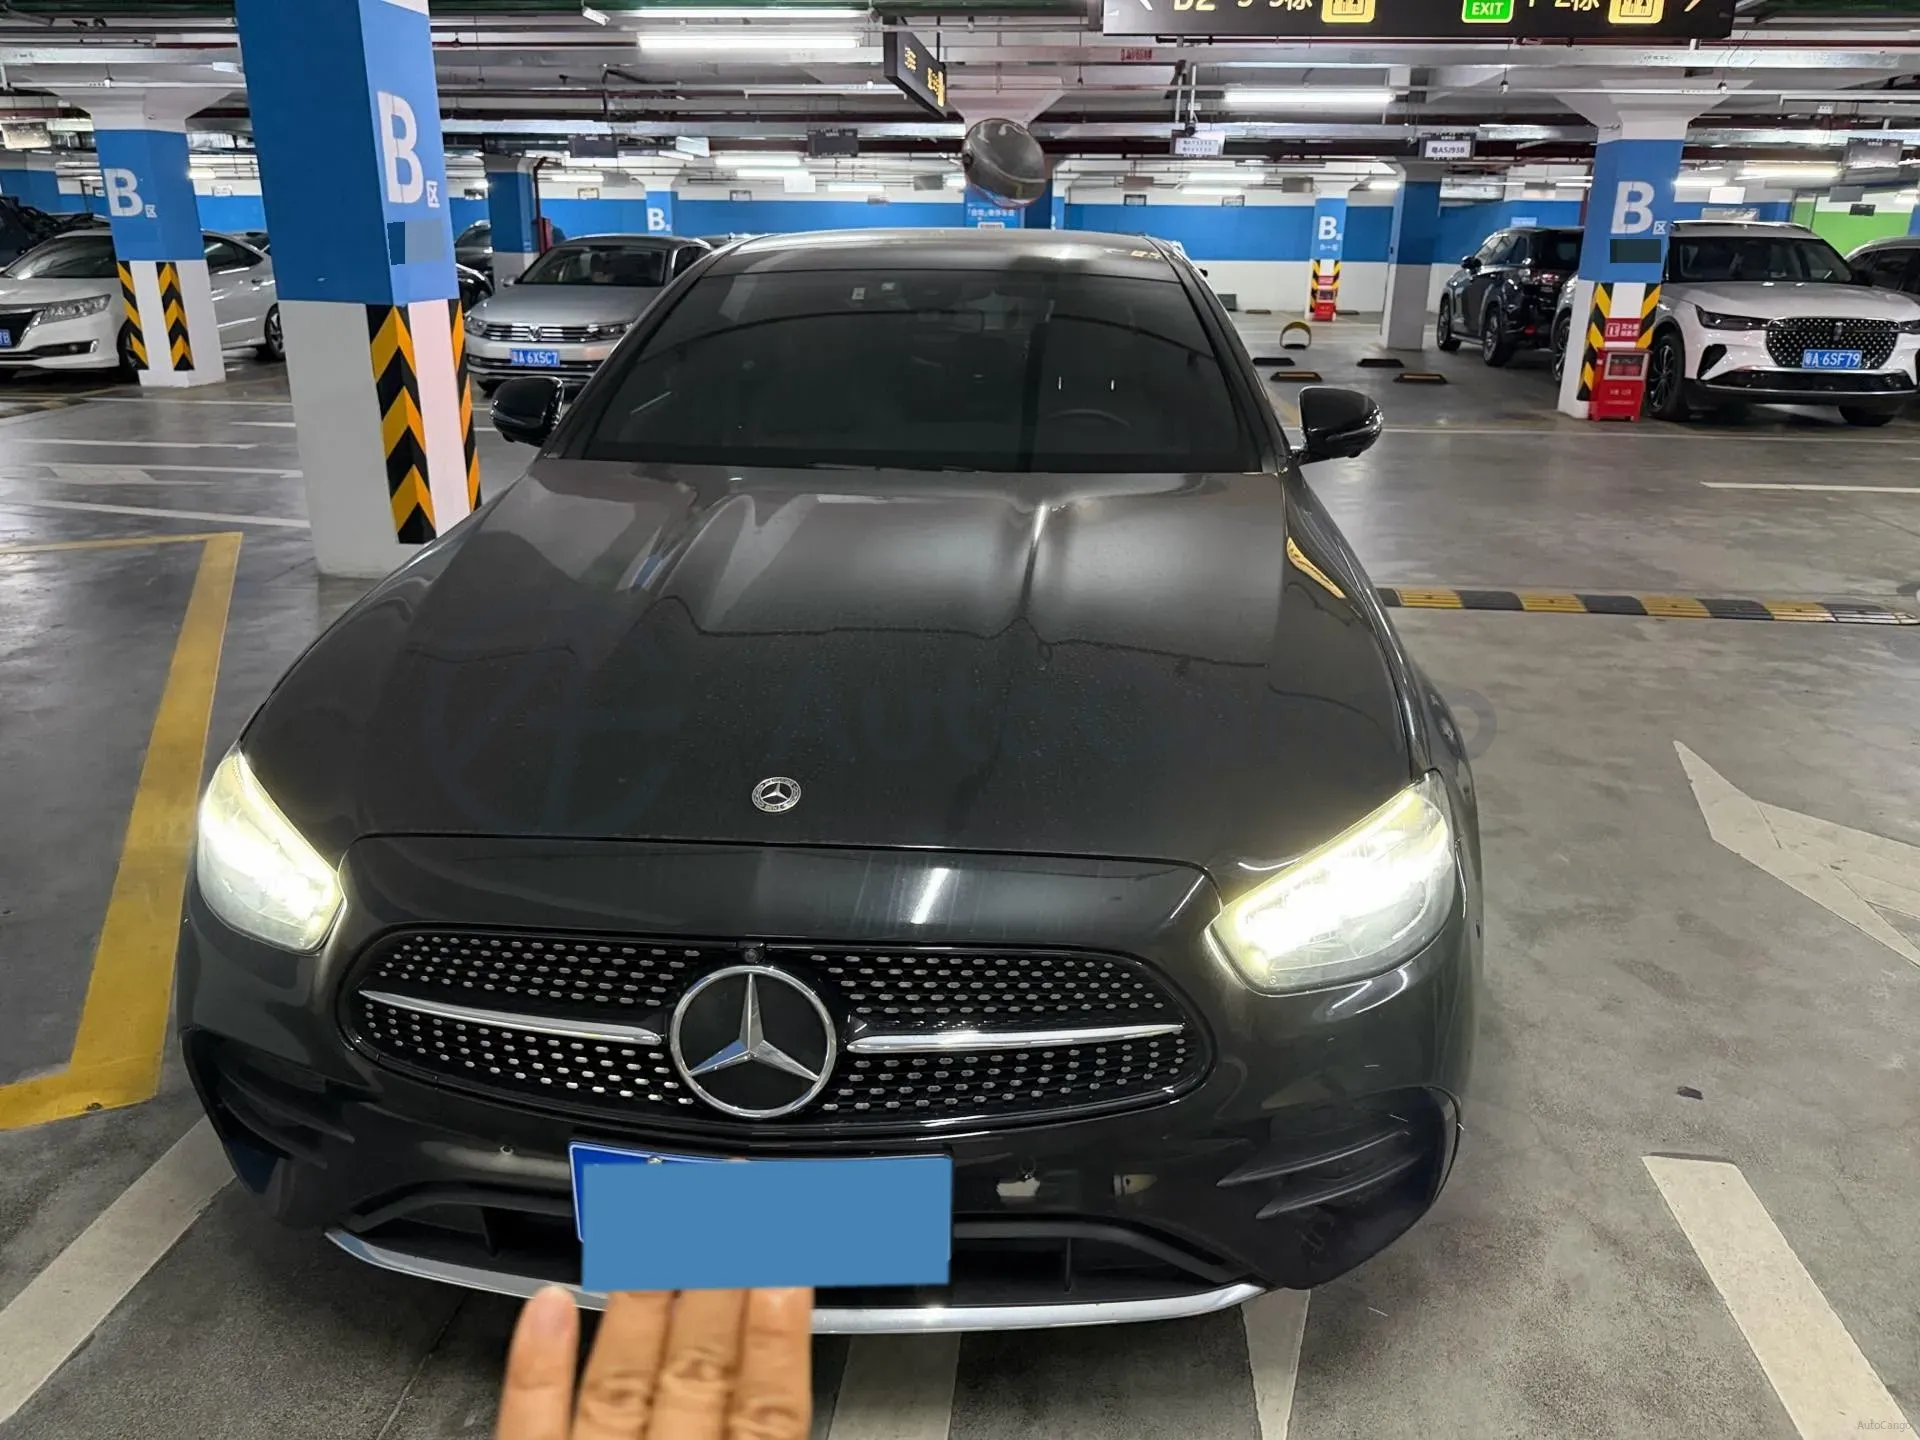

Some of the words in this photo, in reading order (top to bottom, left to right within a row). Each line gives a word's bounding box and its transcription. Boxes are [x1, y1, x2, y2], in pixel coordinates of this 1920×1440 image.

[1472, 2, 1504, 16] EXIT
[648, 207, 671, 231] B
[1319, 216, 1343, 240] B
